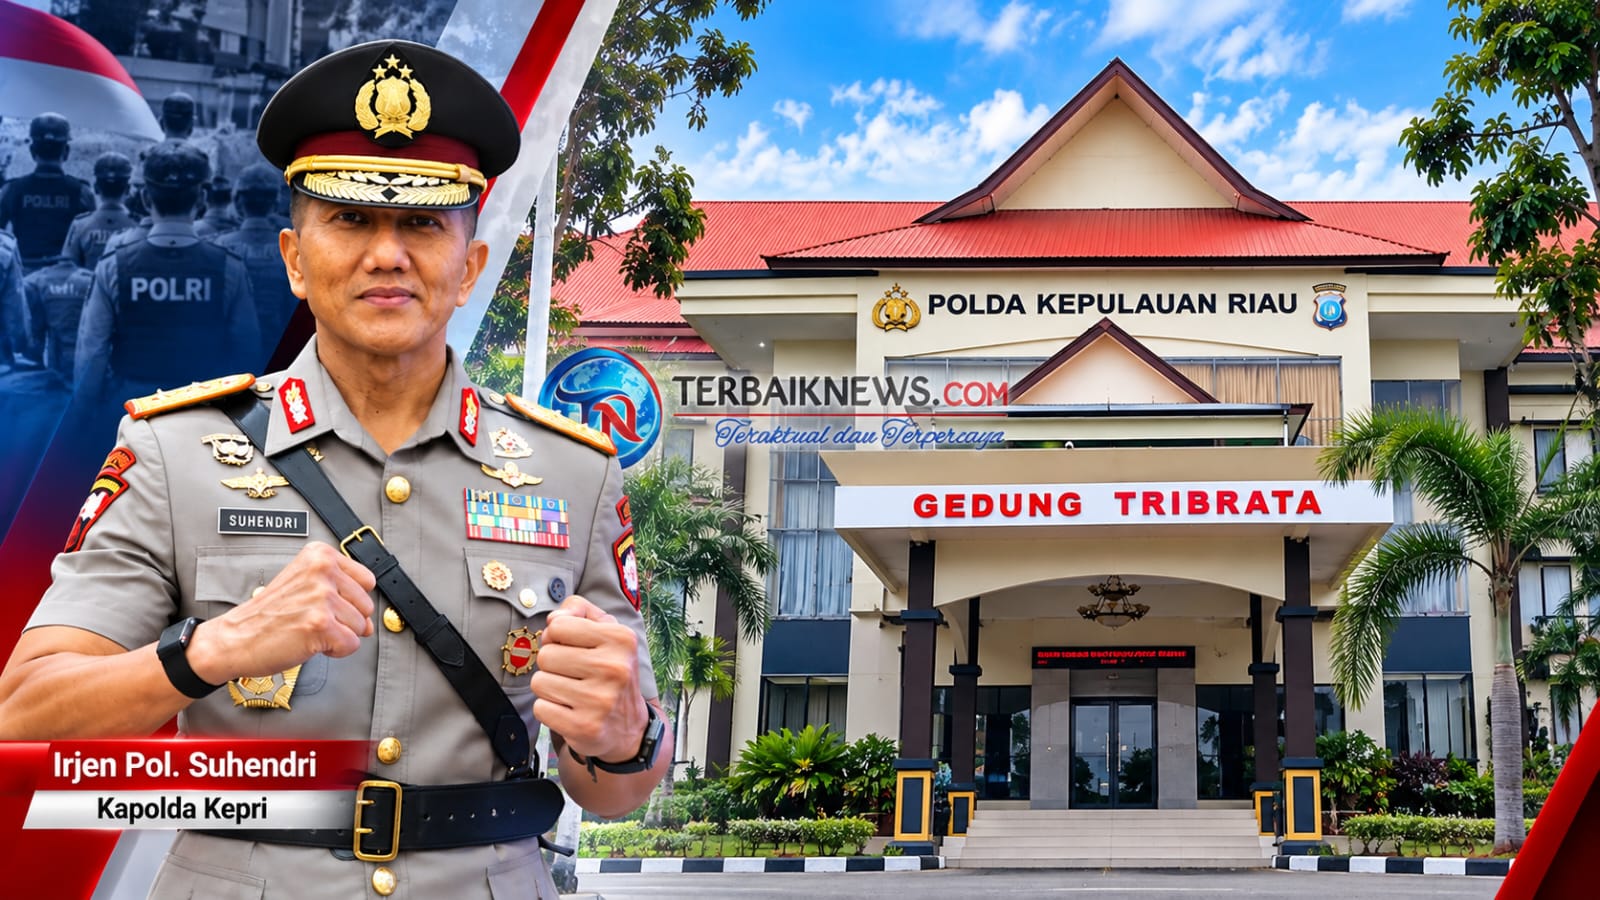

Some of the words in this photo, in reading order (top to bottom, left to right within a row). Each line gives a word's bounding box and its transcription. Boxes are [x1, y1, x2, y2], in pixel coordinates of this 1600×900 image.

[131, 277, 211, 301] POLRI
[928, 294, 1025, 315] POLDA
[1036, 293, 1217, 314] KEPULAUAN
[1228, 293, 1298, 314] RIAU
[913, 492, 1082, 518] GEDUNG
[1114, 490, 1322, 515] TRIBRATA
[229, 514, 298, 529] SUHENDRI
